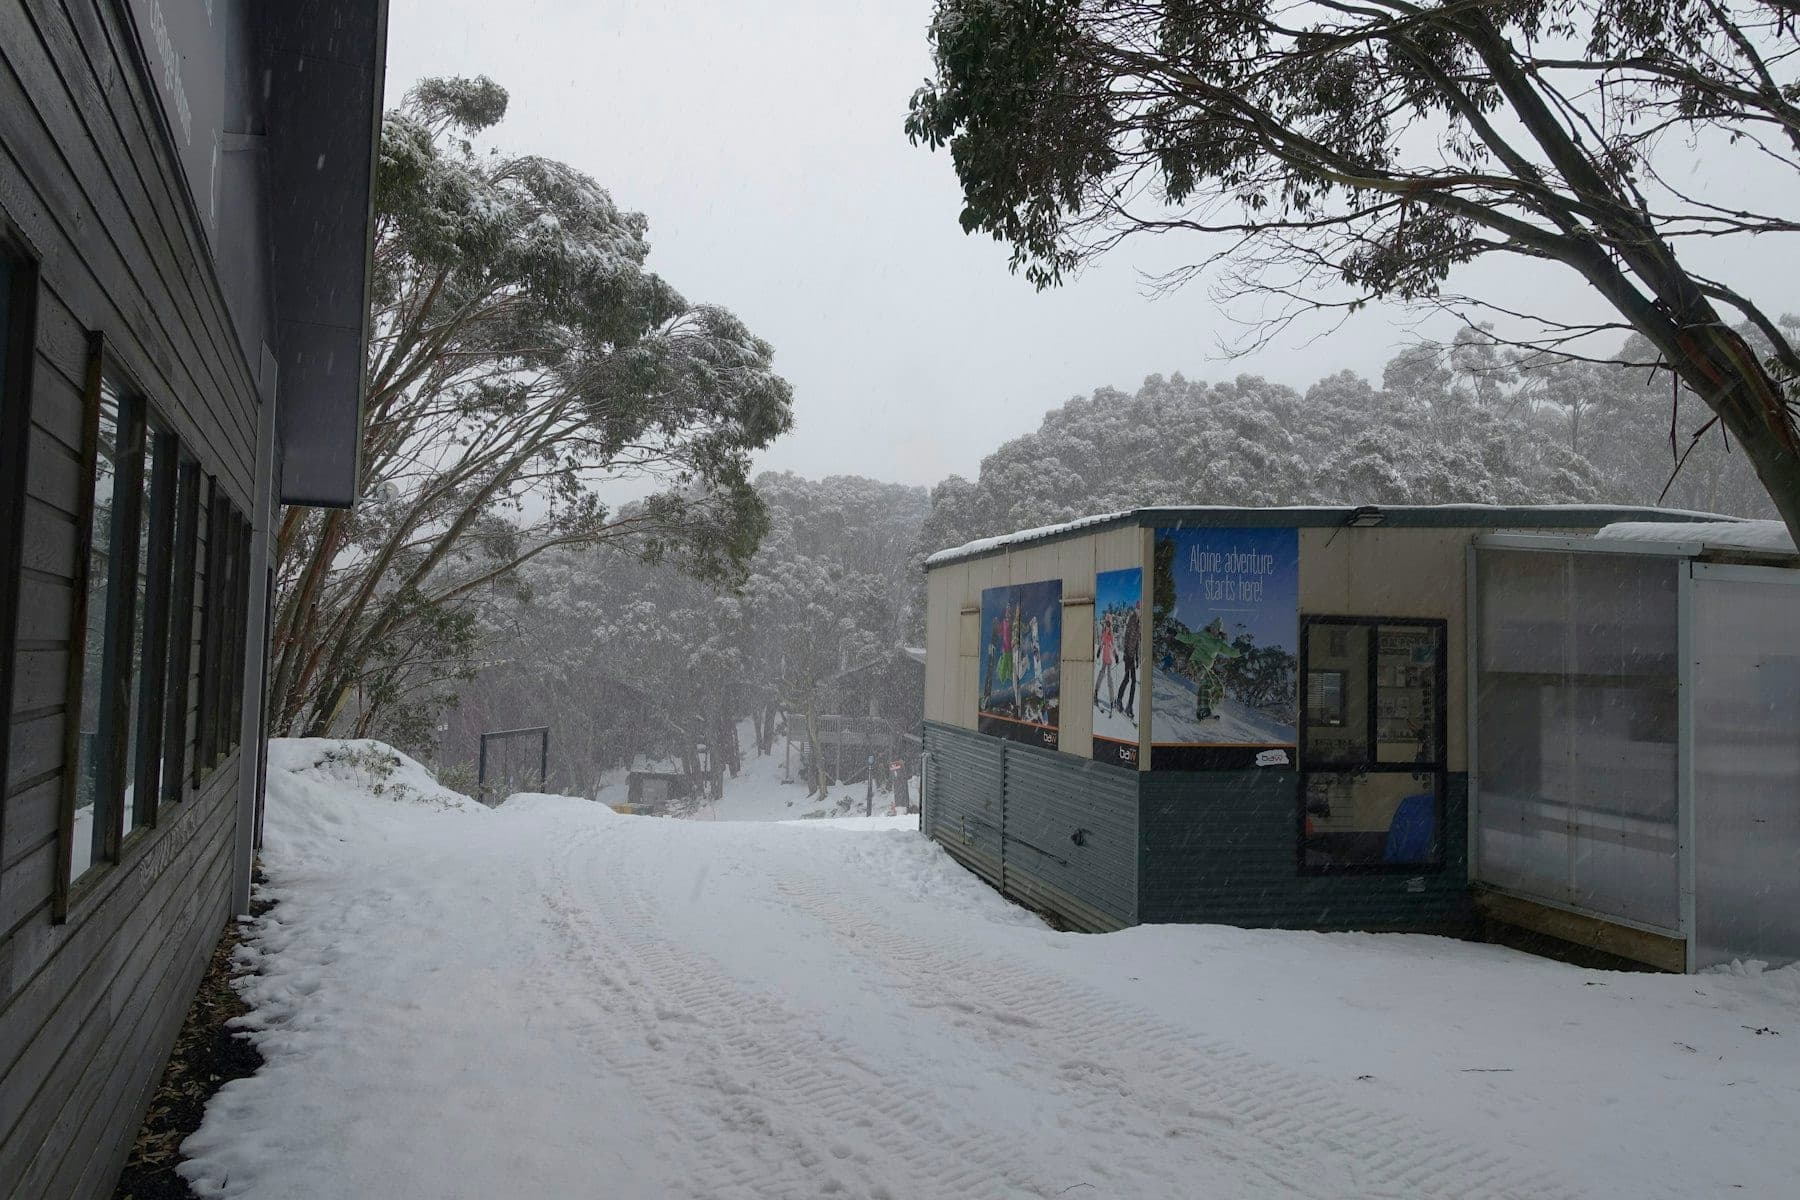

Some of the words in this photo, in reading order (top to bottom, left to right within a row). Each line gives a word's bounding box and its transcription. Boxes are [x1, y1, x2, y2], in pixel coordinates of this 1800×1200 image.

[1190, 544, 1221, 584] Alpine
[1224, 545, 1273, 575] adventure
[1205, 574, 1235, 601] starts
[1238, 574, 1263, 602] here!
[1043, 732, 1056, 743] baw
[1119, 746, 1136, 761] baw
